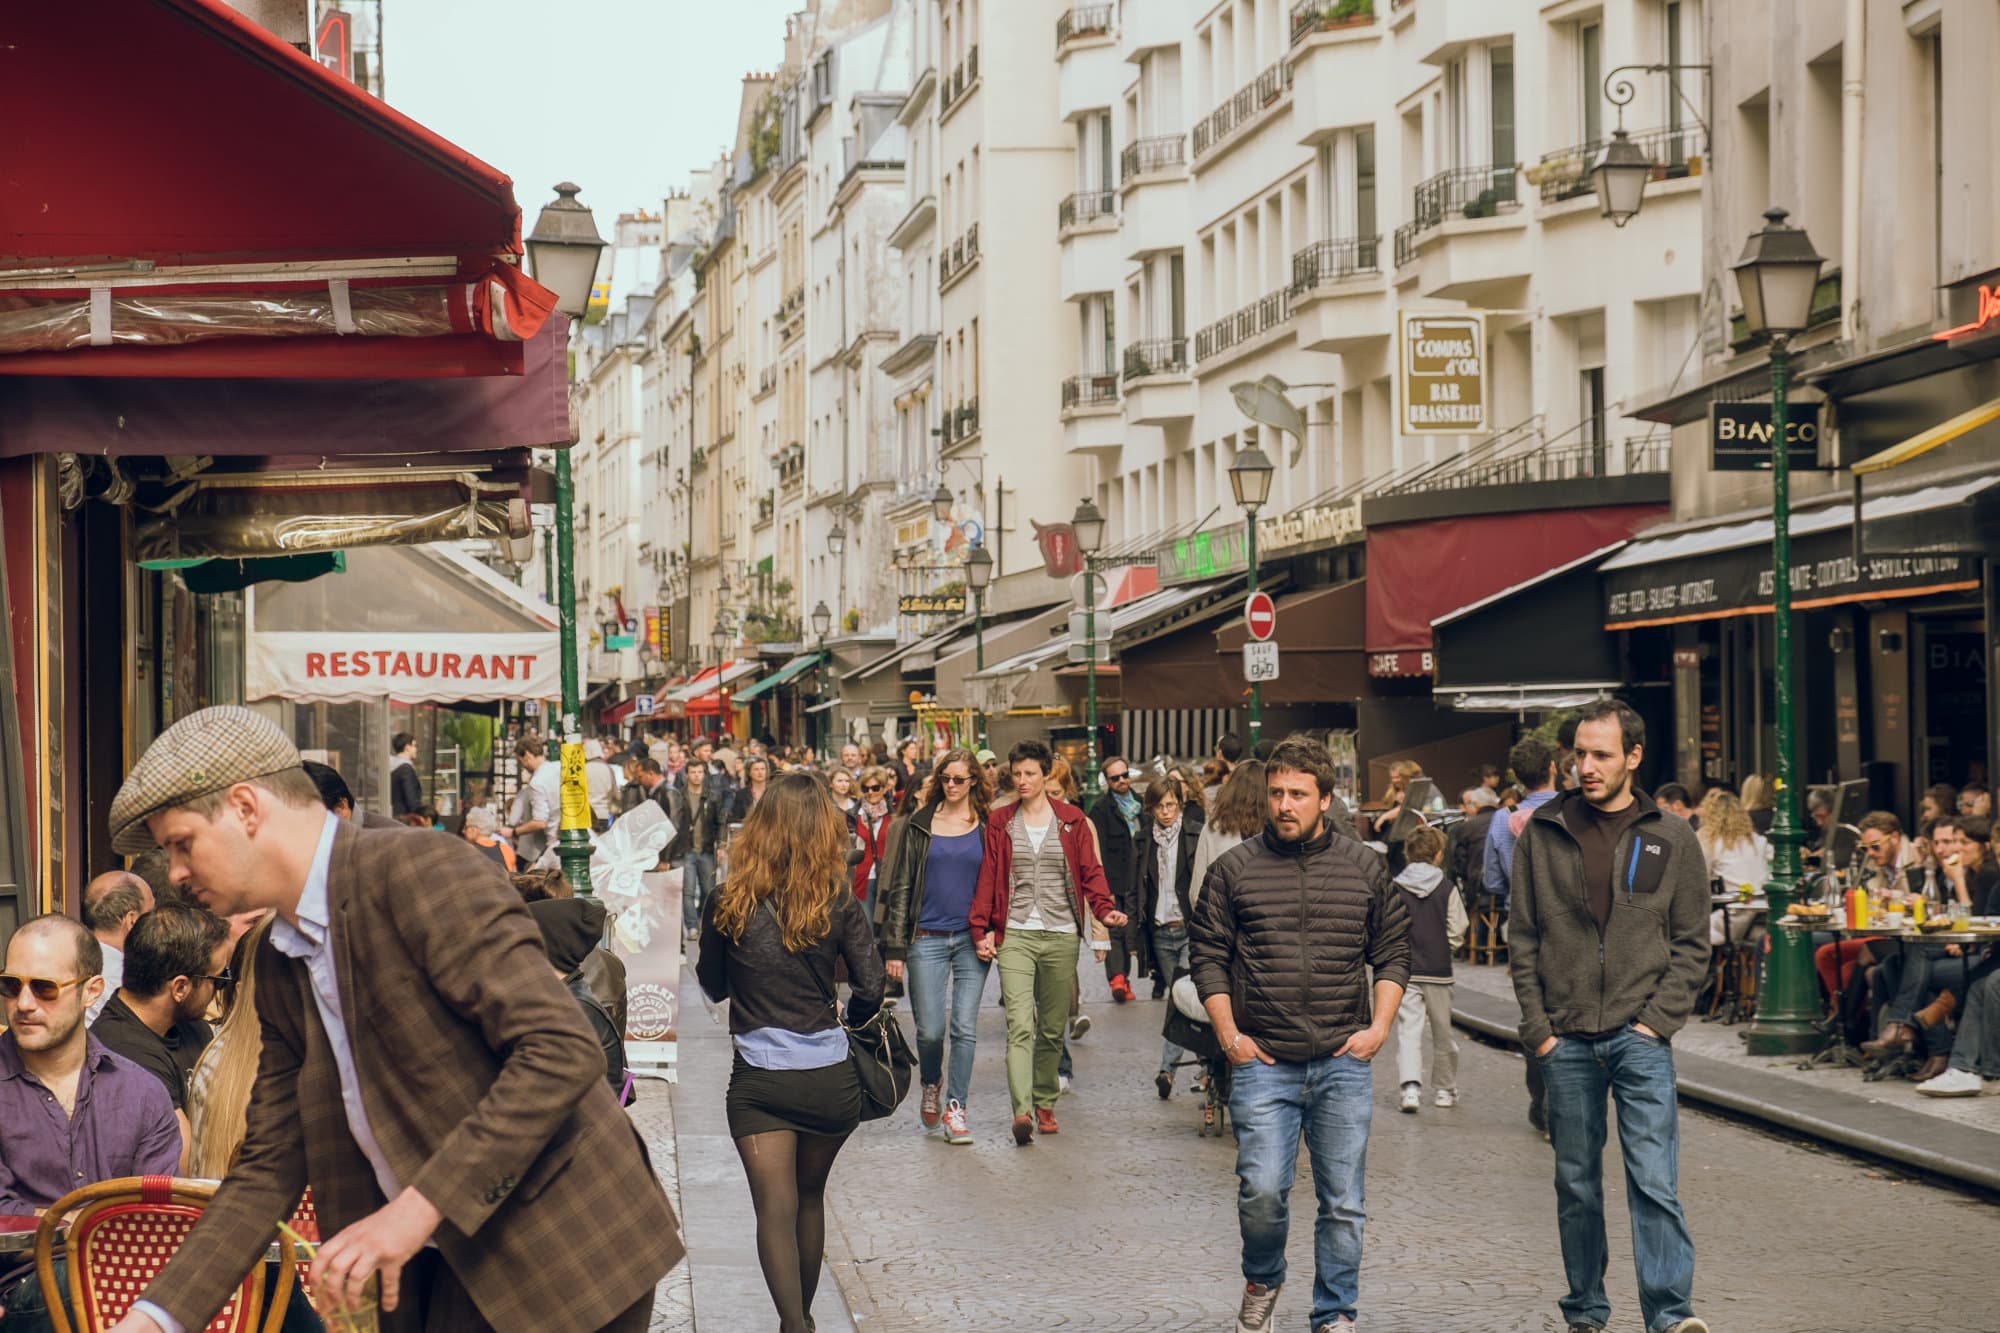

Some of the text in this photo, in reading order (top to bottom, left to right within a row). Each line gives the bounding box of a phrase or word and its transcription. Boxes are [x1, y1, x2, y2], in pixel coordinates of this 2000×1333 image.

[1408, 321, 1424, 339] LE
[1416, 340, 1473, 358] COMPAS
[1445, 358, 1480, 376] d'OR
[1430, 383, 1460, 401] BAR
[1409, 405, 1482, 422] BRASSERIE
[1252, 645, 1271, 656] SAUF
[306, 651, 537, 680] RESTAURANT
